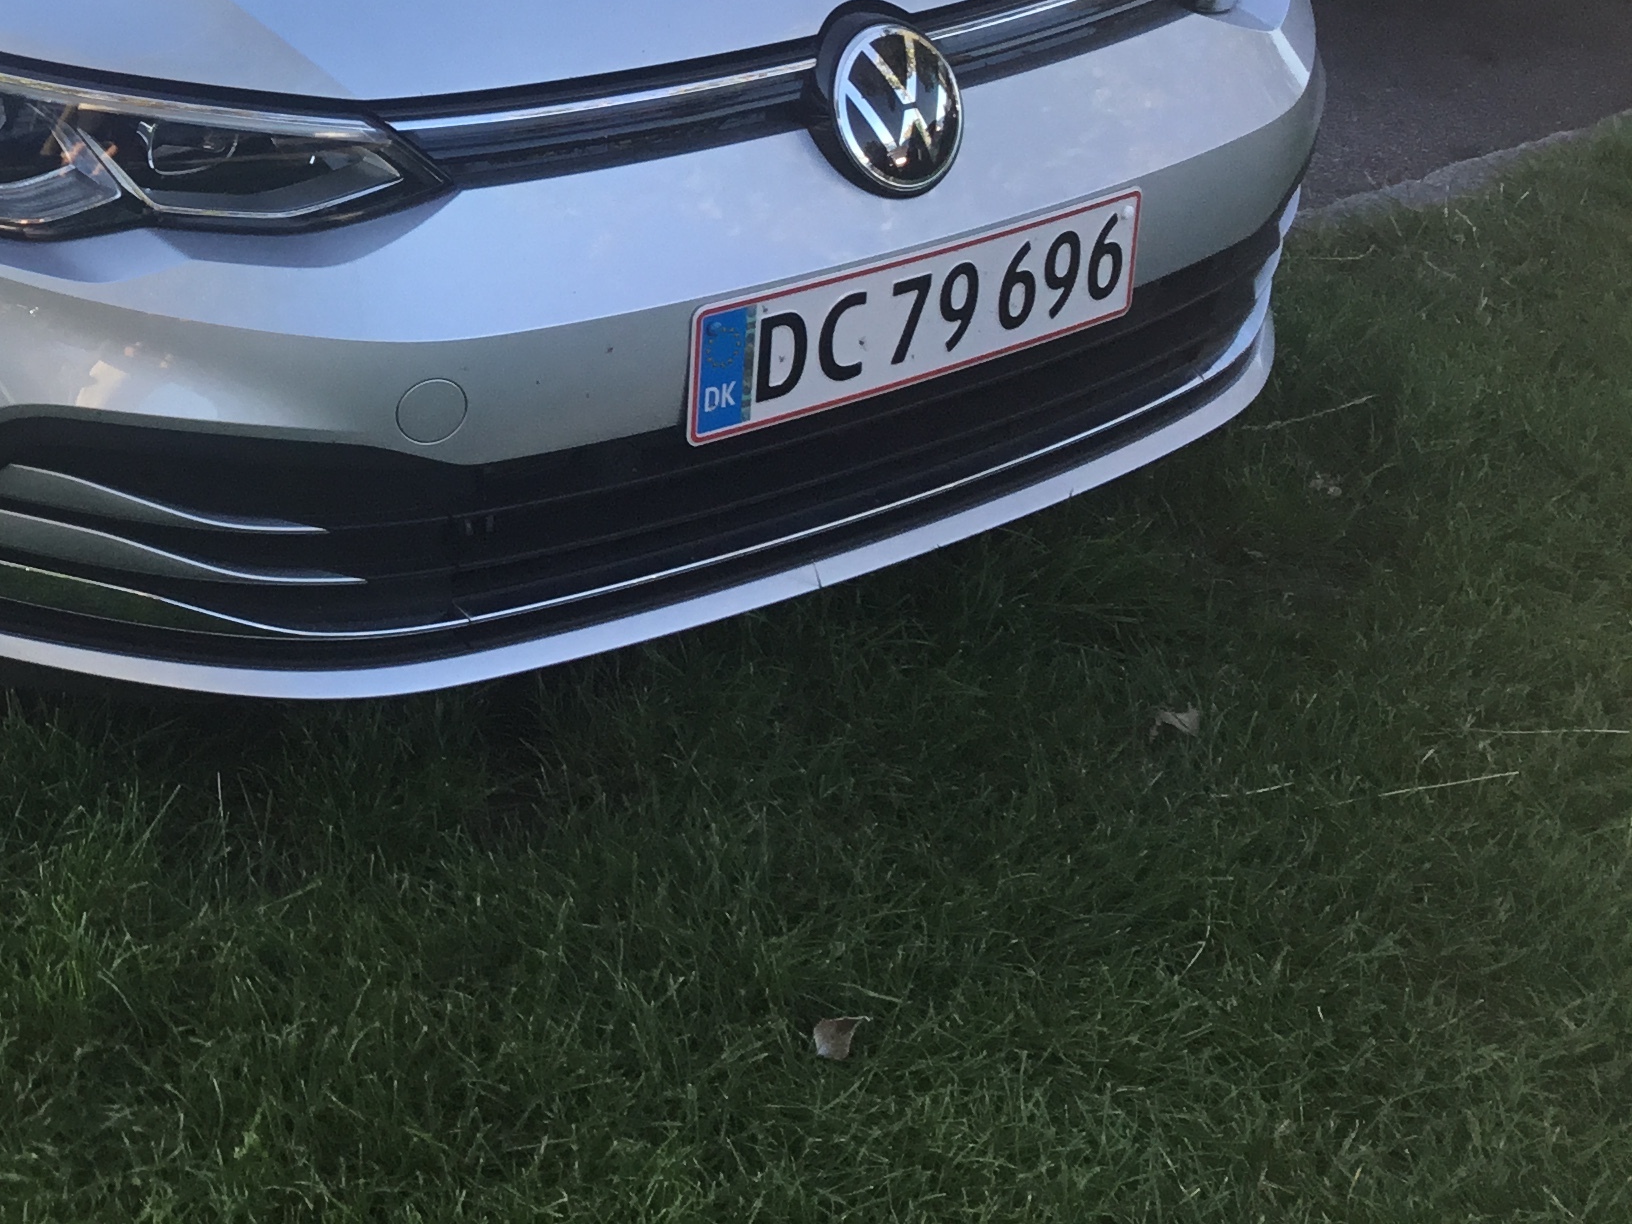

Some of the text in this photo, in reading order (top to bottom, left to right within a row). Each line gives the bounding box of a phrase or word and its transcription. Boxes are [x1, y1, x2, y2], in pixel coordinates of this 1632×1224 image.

[756, 212, 1124, 403] DC 79 696
[704, 380, 737, 413] DK
